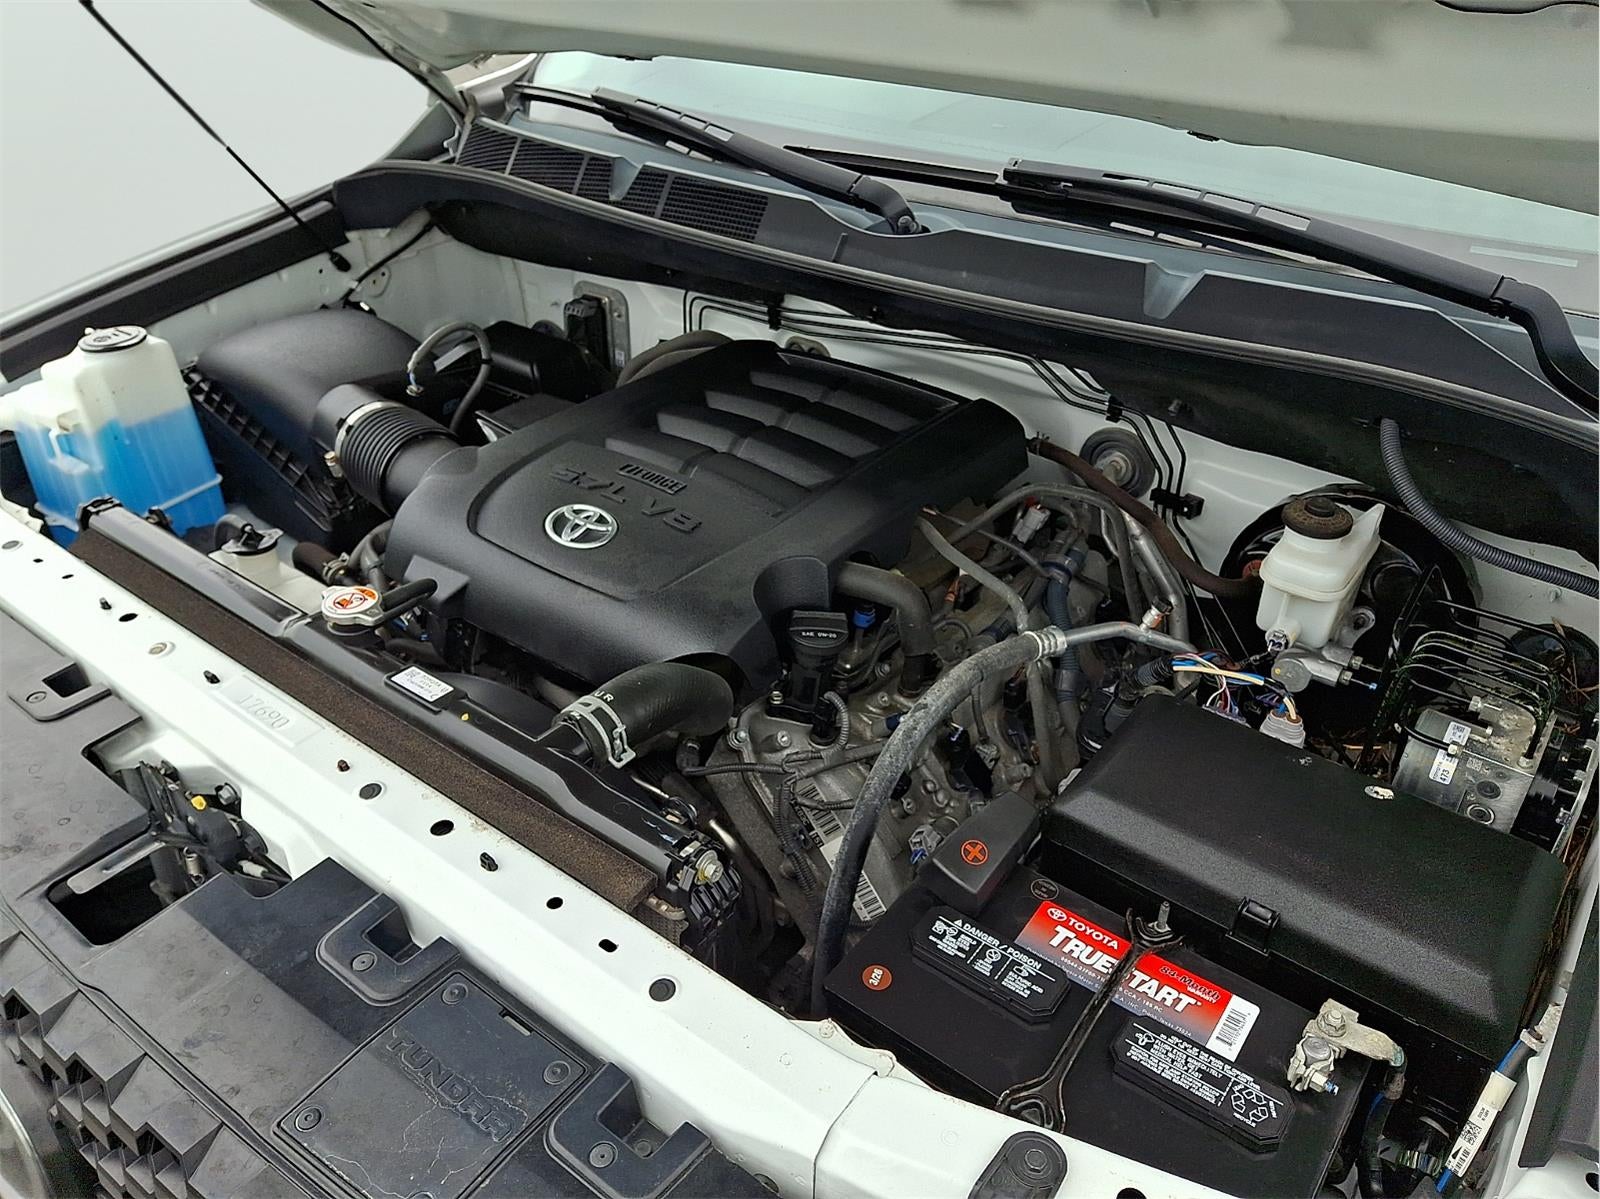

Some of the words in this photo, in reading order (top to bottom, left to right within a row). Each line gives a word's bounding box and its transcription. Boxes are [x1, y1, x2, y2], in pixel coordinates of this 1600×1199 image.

[641, 499, 702, 533] V8
[1440, 768, 1450, 782] 473
[963, 923, 1000, 948] DANGER
[1006, 947, 1042, 971] POISON
[1068, 917, 1118, 950] TOYOTA
[1049, 925, 1197, 1013] TRUETART
[385, 1027, 514, 1142] TUNDRA
